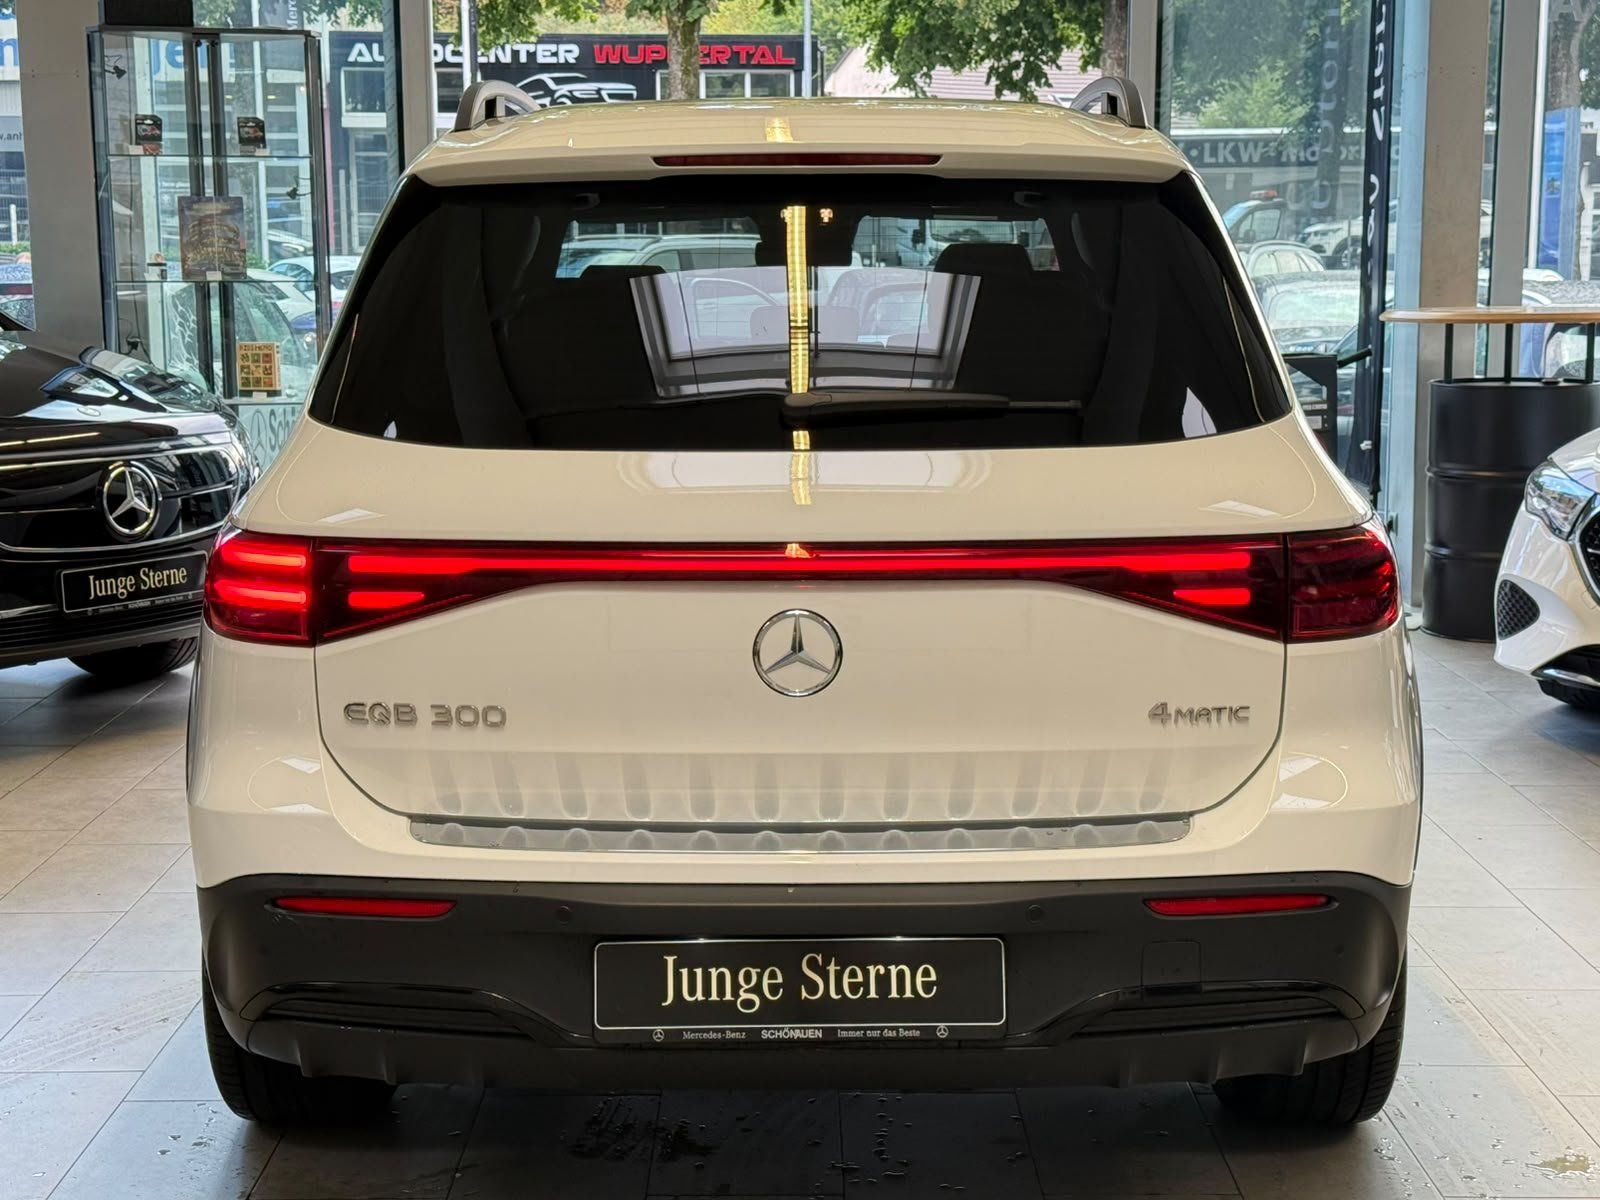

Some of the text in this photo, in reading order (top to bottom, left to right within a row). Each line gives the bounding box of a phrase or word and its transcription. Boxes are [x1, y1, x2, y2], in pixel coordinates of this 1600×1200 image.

[593, 43, 797, 66] WUPERTAL
[1203, 141, 1264, 163] LKW
[268, 407, 297, 453] Sch
[88, 566, 188, 600] Junge Sterne
[343, 702, 507, 728] EQB 300
[1148, 701, 1250, 726] 4MATIC
[661, 952, 938, 1013] Junge Sterne
[682, 1030, 747, 1040] Mercedes-Benz
[837, 1028, 865, 1038] Immer
[866, 1030, 881, 1038] nur
[882, 1028, 897, 1038] das
[898, 1027, 921, 1037] Beste
